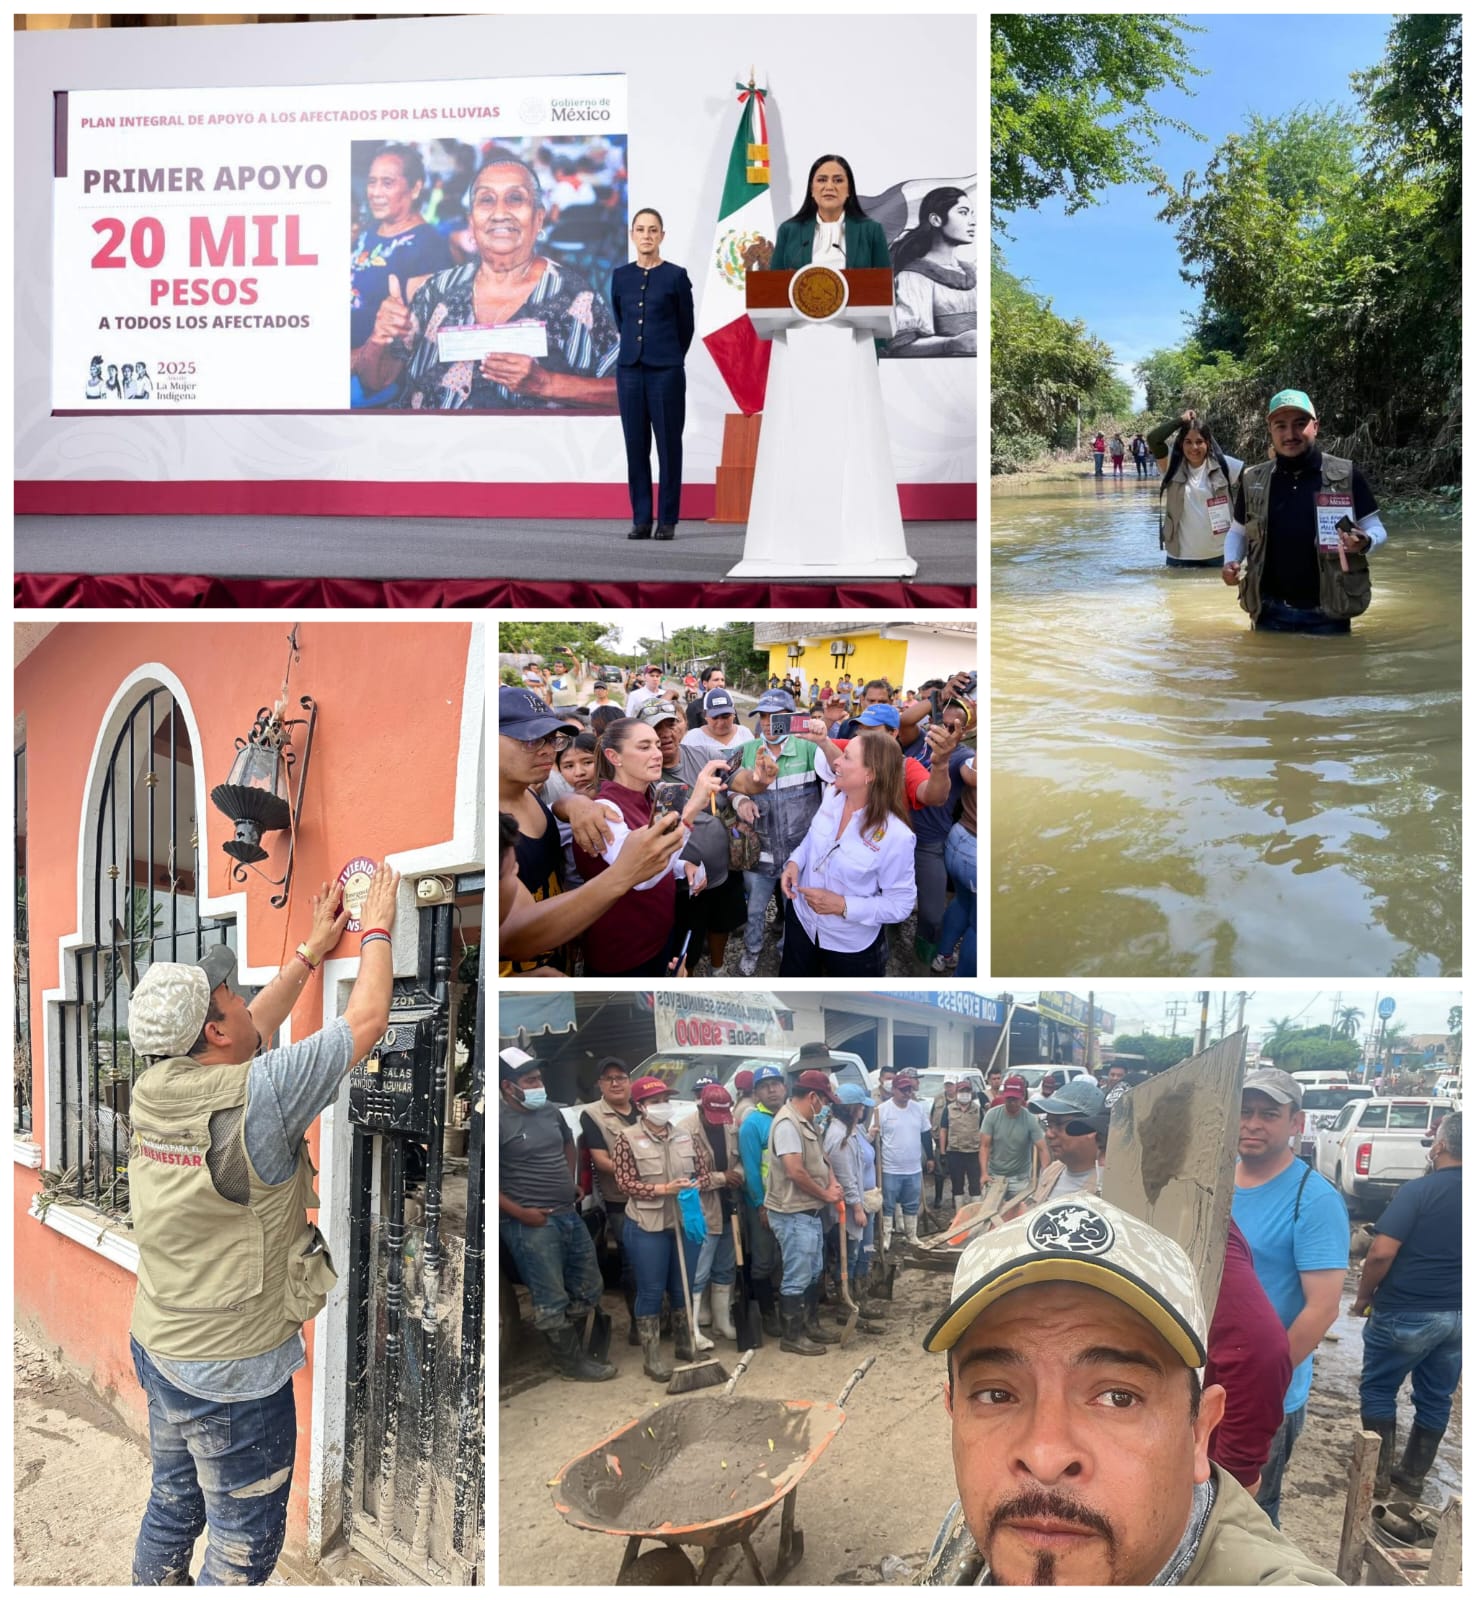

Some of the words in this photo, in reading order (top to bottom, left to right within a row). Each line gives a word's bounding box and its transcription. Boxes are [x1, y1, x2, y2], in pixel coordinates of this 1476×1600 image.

[551, 98, 597, 107] Gobierno
[599, 97, 611, 106] de
[81, 117, 116, 128] PLAN
[119, 115, 184, 127] INTEGRAL
[188, 114, 204, 125] DE
[208, 113, 254, 125] APOYO
[258, 112, 267, 123] A
[271, 111, 296, 123] LOS
[300, 110, 377, 122] AFECTADOS
[381, 108, 408, 120] POR
[413, 108, 437, 120] LAS
[441, 106, 500, 119] LLUVIAS
[551, 106, 610, 121] México
[83, 167, 205, 194] PRIMER
[213, 164, 328, 191] APOYO
[90, 216, 166, 269] 20
[189, 214, 319, 267] MIL
[150, 277, 259, 306] PESOS
[98, 316, 111, 330] A
[115, 316, 171, 330] TODOS
[176, 316, 208, 329] LOS
[212, 314, 310, 329] AFECTADOS
[157, 361, 196, 375] 2025
[156, 382, 167, 390] La
[170, 381, 197, 391] Mujer
[340, 860, 374, 885] IVIEND
[392, 996, 416, 1006] ZON
[351, 1064, 374, 1076] REYE
[382, 1067, 412, 1079] SALAS
[382, 1081, 413, 1093] AGUILAR
[143, 1146, 202, 1167] BIENESTAR
